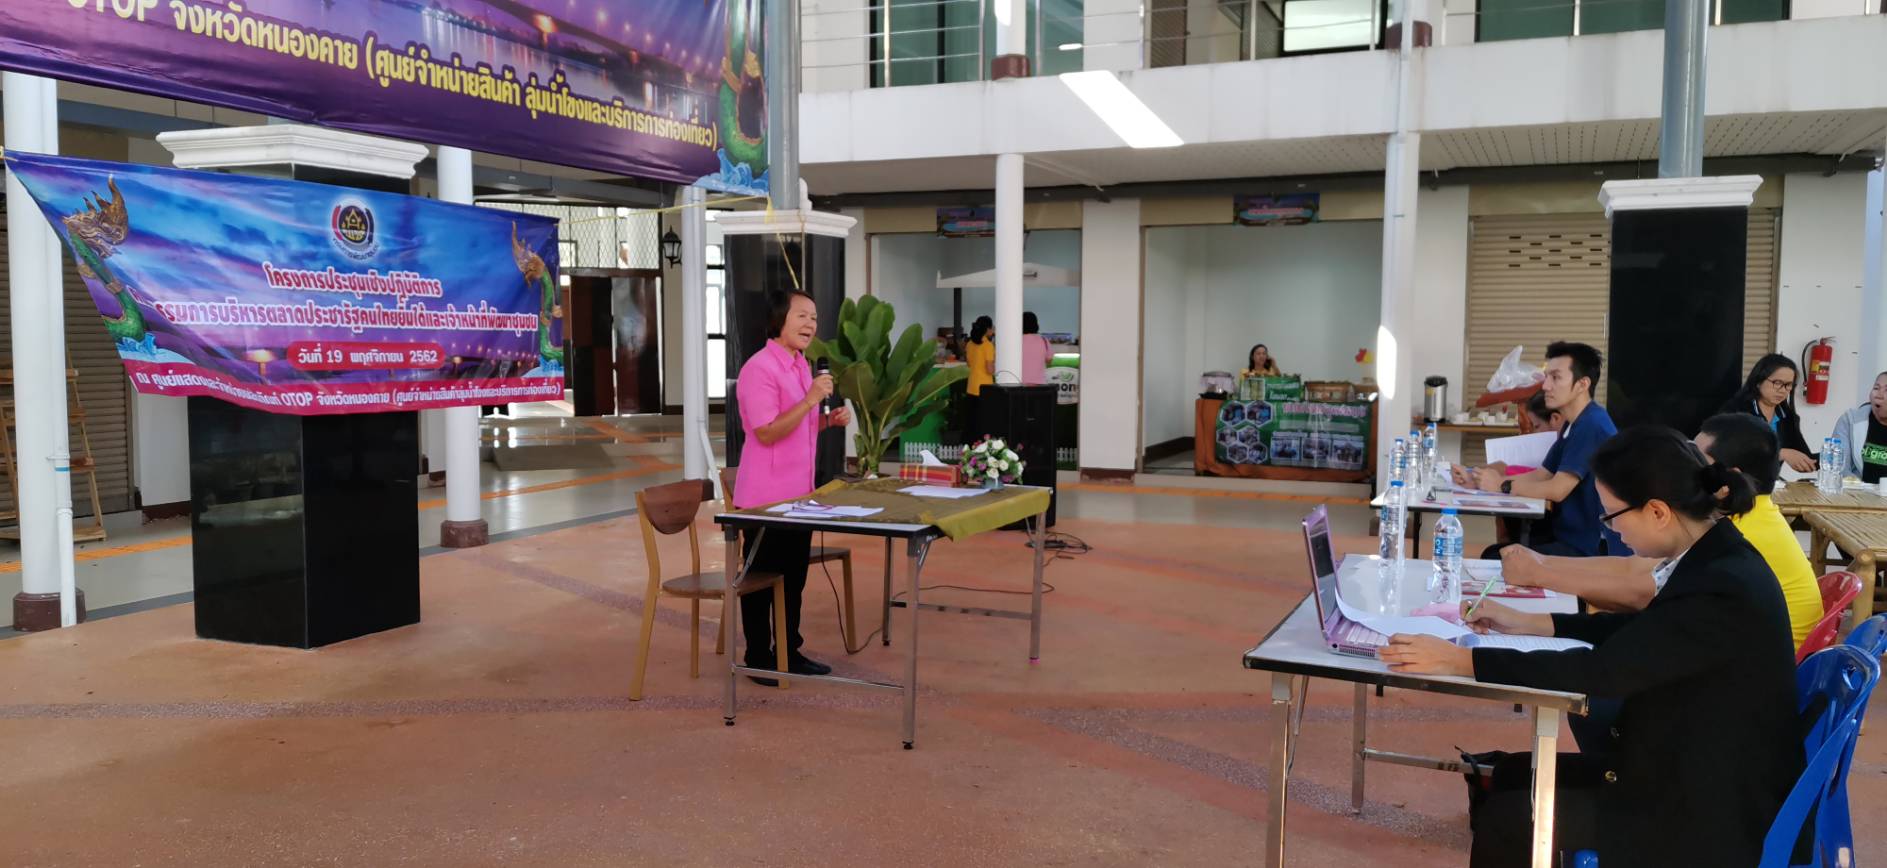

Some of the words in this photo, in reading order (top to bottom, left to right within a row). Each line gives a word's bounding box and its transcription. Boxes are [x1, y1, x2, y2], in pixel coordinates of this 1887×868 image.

[263, 261, 442, 301] โครงการประชุมเชิงปฏิบัติการ
[298, 343, 322, 364] วันที่
[327, 349, 343, 363] 19
[350, 348, 404, 367] พฤศจิกายน
[410, 349, 438, 363] 2562
[281, 392, 313, 408] OTOP
[318, 391, 390, 407] จังหวัดหนองคาย
